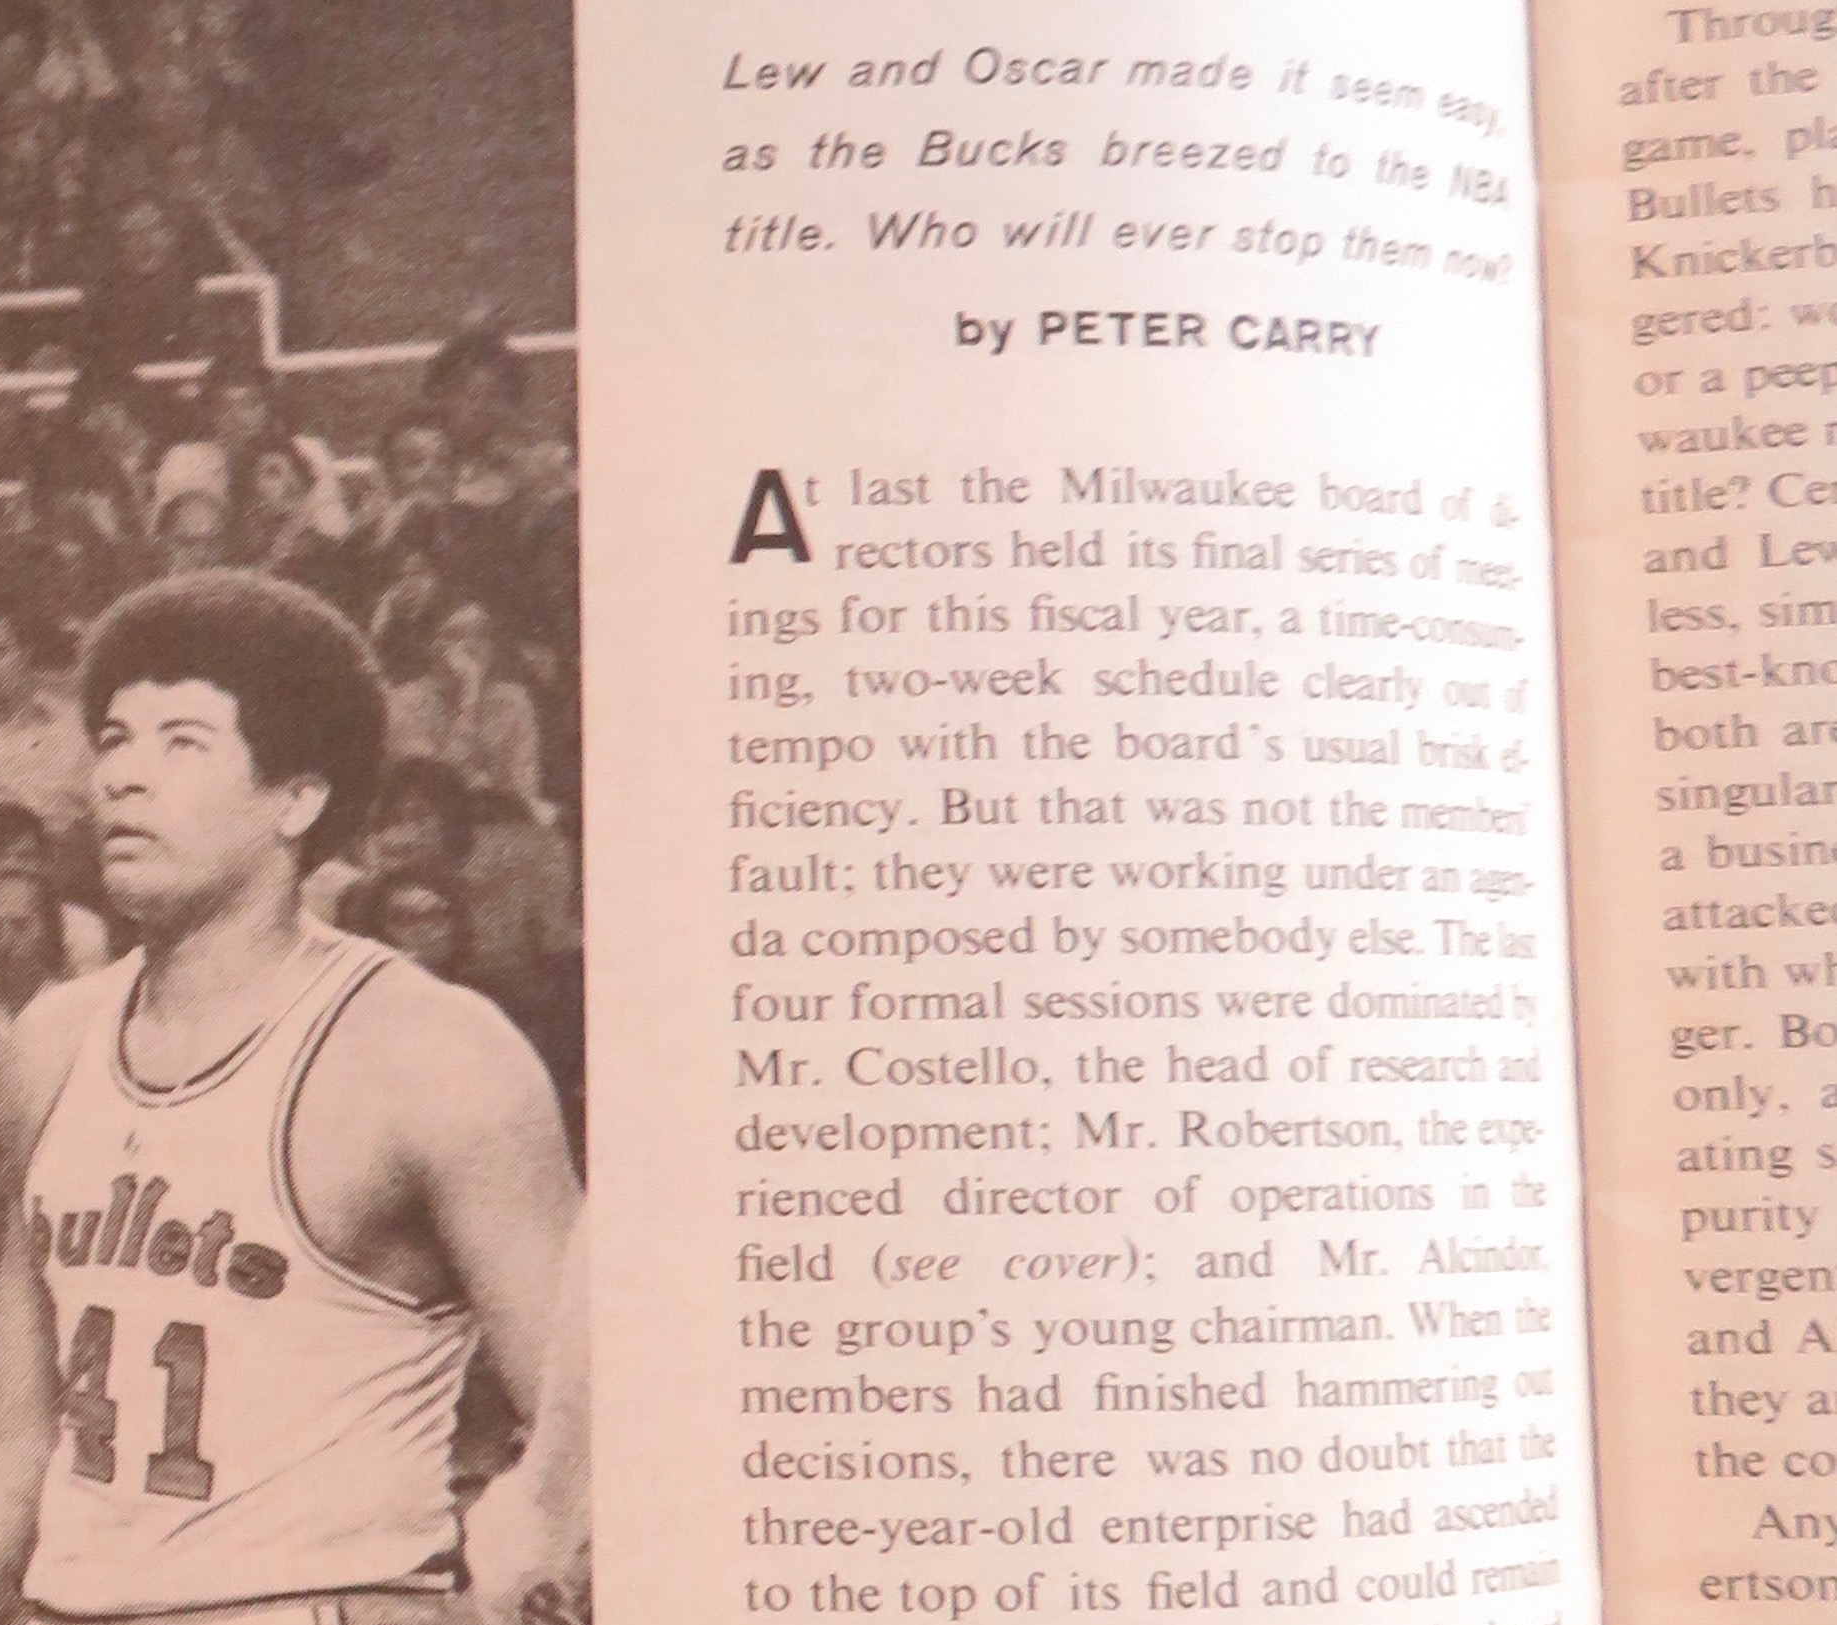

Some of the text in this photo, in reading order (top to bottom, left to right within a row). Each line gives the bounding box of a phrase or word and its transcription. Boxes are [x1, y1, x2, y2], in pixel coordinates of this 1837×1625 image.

[722, 53, 827, 91] Lew
[847, 49, 943, 88] and
[964, 45, 1109, 86] Oscar
[1126, 55, 1253, 91] made
[1277, 60, 1310, 95] it
[1618, 60, 1819, 107] after the
[722, 143, 777, 173] as
[809, 131, 886, 170] the
[917, 129, 1066, 168] Bucks
[1100, 130, 1286, 172] breezed
[1313, 143, 1351, 180] to
[1375, 151, 1430, 191] the
[1627, 181, 1781, 223] Bullets
[725, 214, 834, 253] title.
[869, 211, 977, 250] Who
[1004, 211, 1094, 248] will
[1113, 221, 1216, 251] ever
[1231, 219, 1325, 265] stop
[1343, 226, 1431, 267] them
[956, 310, 1379, 356] by PETER CARRY
[1637, 414, 1809, 455] waukee
[851, 467, 931, 507] last
[960, 466, 1030, 505] the
[1060, 466, 1295, 509] Milwaukee
[1318, 471, 1424, 517] board
[1640, 474, 1752, 515] title?
[835, 538, 994, 571] rectors
[1011, 529, 1105, 569] held
[1128, 529, 1178, 570] its
[1191, 530, 1282, 571] final
[1298, 545, 1399, 577] series
[1409, 543, 1446, 581] of
[1643, 535, 1729, 575] and
[728, 733, 875, 772] tempo
[898, 721, 998, 761] with
[1022, 721, 1091, 761] the
[1303, 728, 1400, 766] usual
[1653, 712, 1759, 752] both
[730, 919, 787, 958] da
[800, 915, 1037, 965] composed
[1052, 914, 1106, 963] by
[1120, 915, 1334, 963] somebody
[1348, 917, 1424, 956] else.
[1666, 953, 1767, 991] with
[737, 1048, 821, 1087] Mr.
[845, 1045, 1053, 1088] Costello,
[1075, 1045, 1145, 1085] the
[1166, 1044, 1270, 1084] head
[1287, 1043, 1335, 1084] of
[1670, 1024, 1753, 1061] ger.
[734, 1112, 1051, 1160] development;
[1076, 1110, 1156, 1149] Mr.
[1417, 1109, 1468, 1147] the
[1677, 1135, 1795, 1180] ating
[1681, 1195, 1818, 1243] purity
[738, 1308, 811, 1349] the
[1033, 1318, 1176, 1356] young
[1189, 1304, 1394, 1346] chairman.
[1407, 1300, 1502, 1338] When
[1687, 1318, 1774, 1356] and
[62, 1305, 215, 1503] 41
[1690, 1379, 1788, 1425] they
[1695, 1441, 1766, 1478] the
[743, 1504, 1073, 1555] three-year-old
[1100, 1502, 1316, 1552] enterprise
[1342, 1497, 1412, 1538] had
